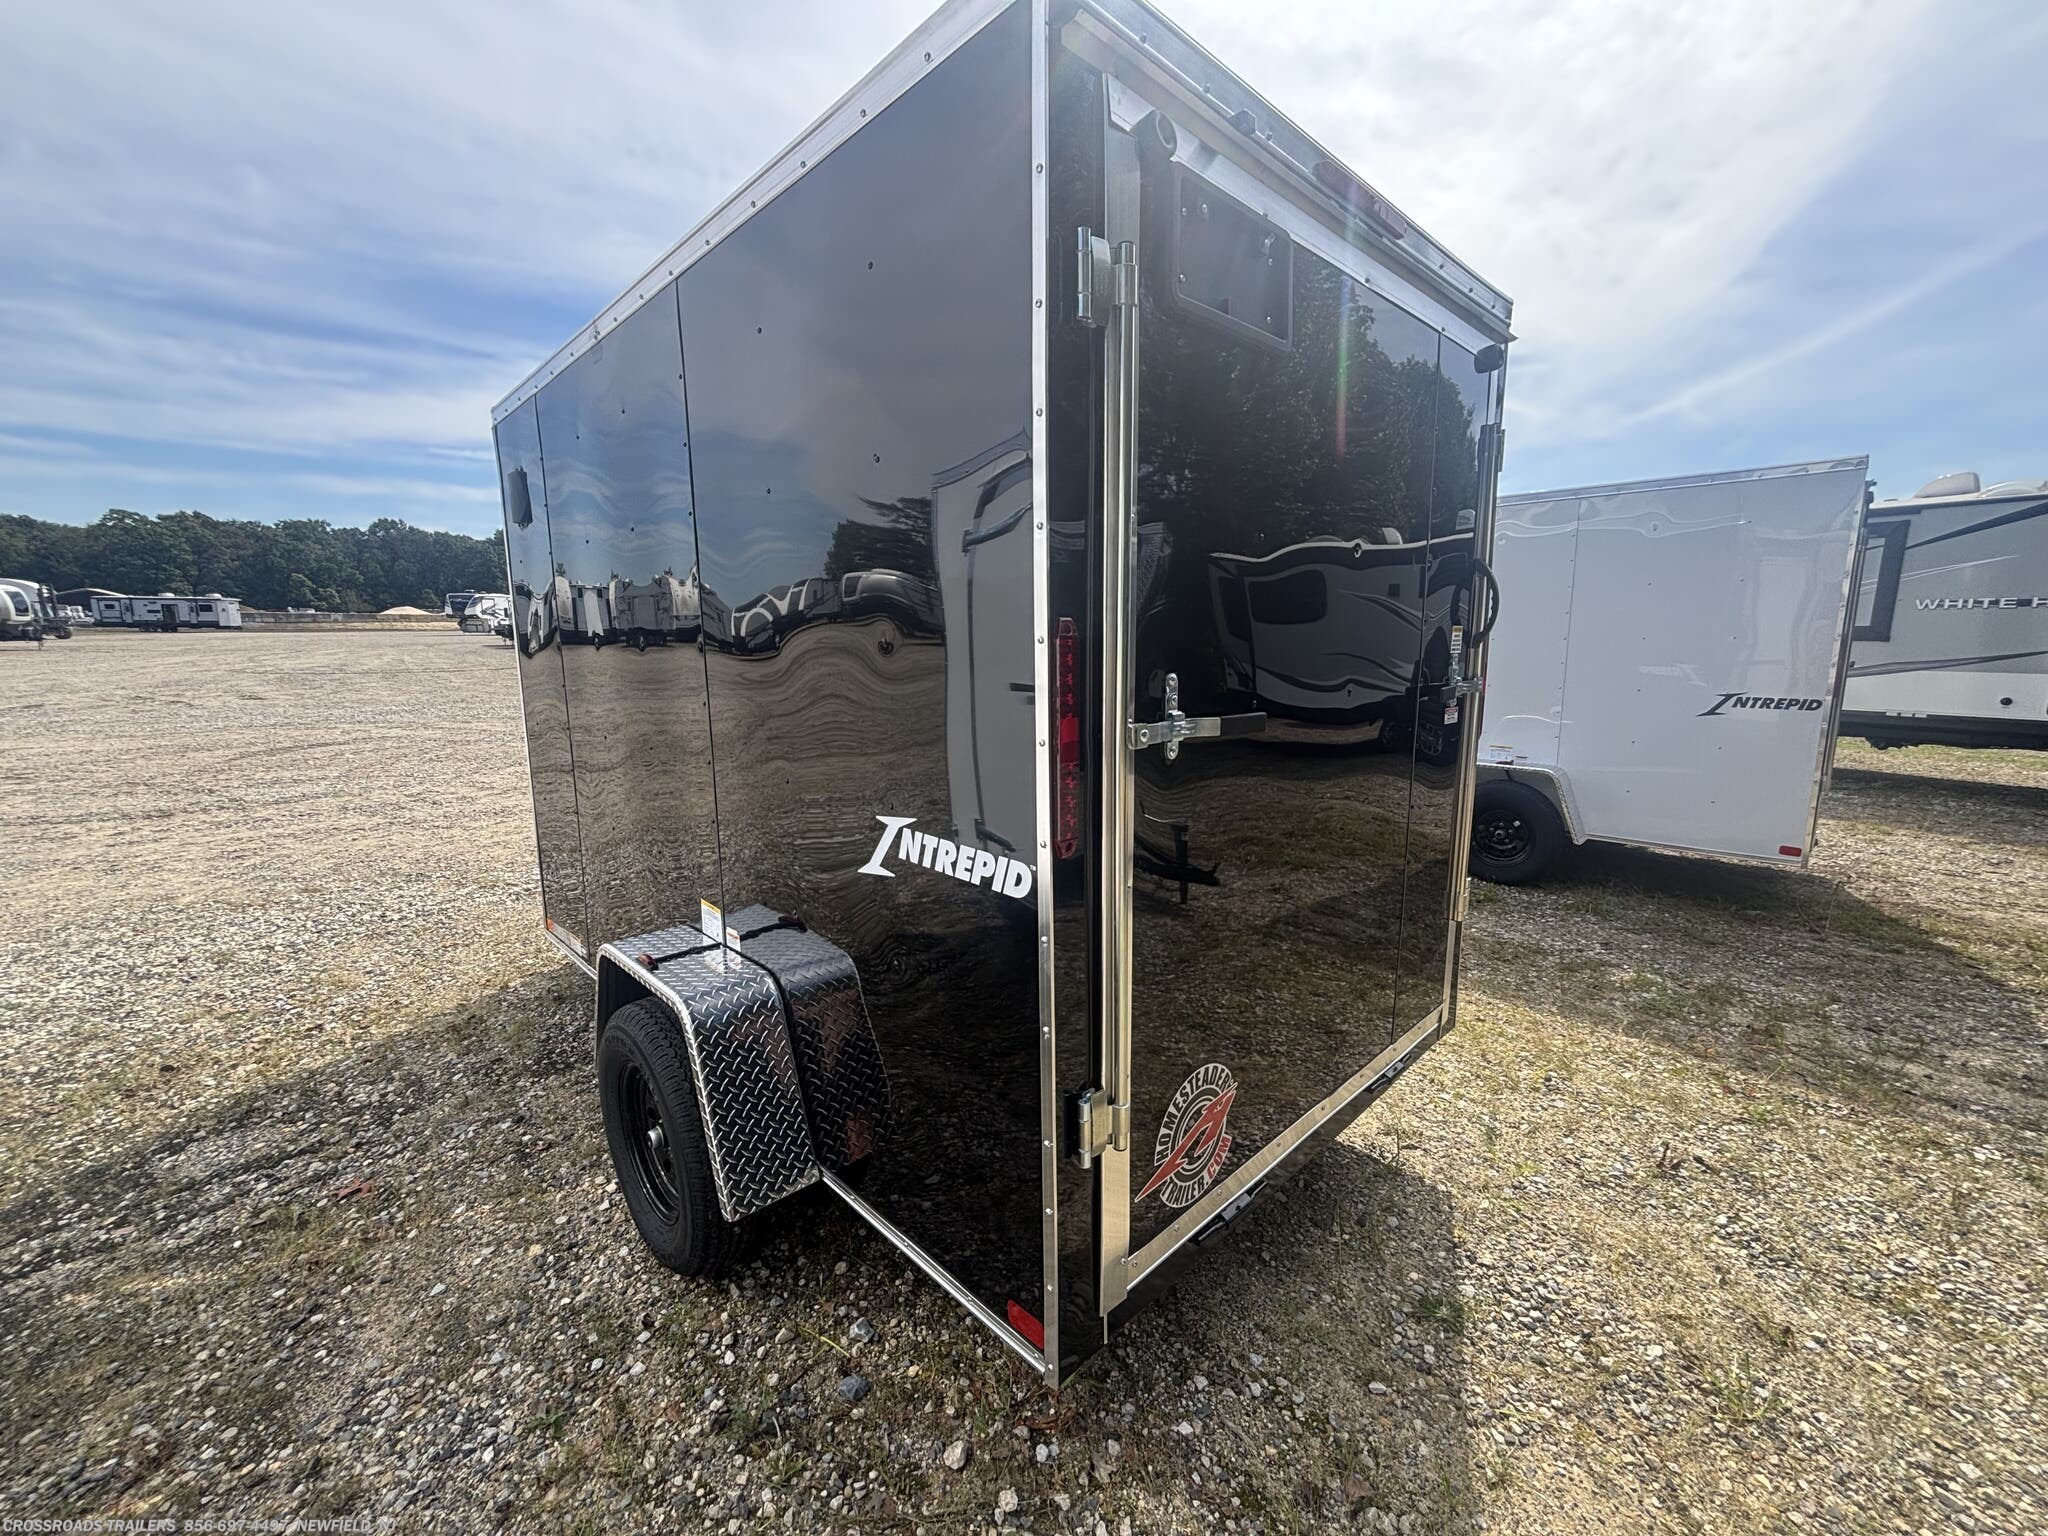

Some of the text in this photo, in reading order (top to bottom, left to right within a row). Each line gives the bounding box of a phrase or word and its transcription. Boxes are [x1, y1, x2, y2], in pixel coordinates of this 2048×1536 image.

[1915, 596, 2018, 610] WHITE
[1696, 692, 1824, 717] INTREPID
[857, 815, 1034, 899] INTREPID
[1156, 1065, 1231, 1162] HOMESTEADER
